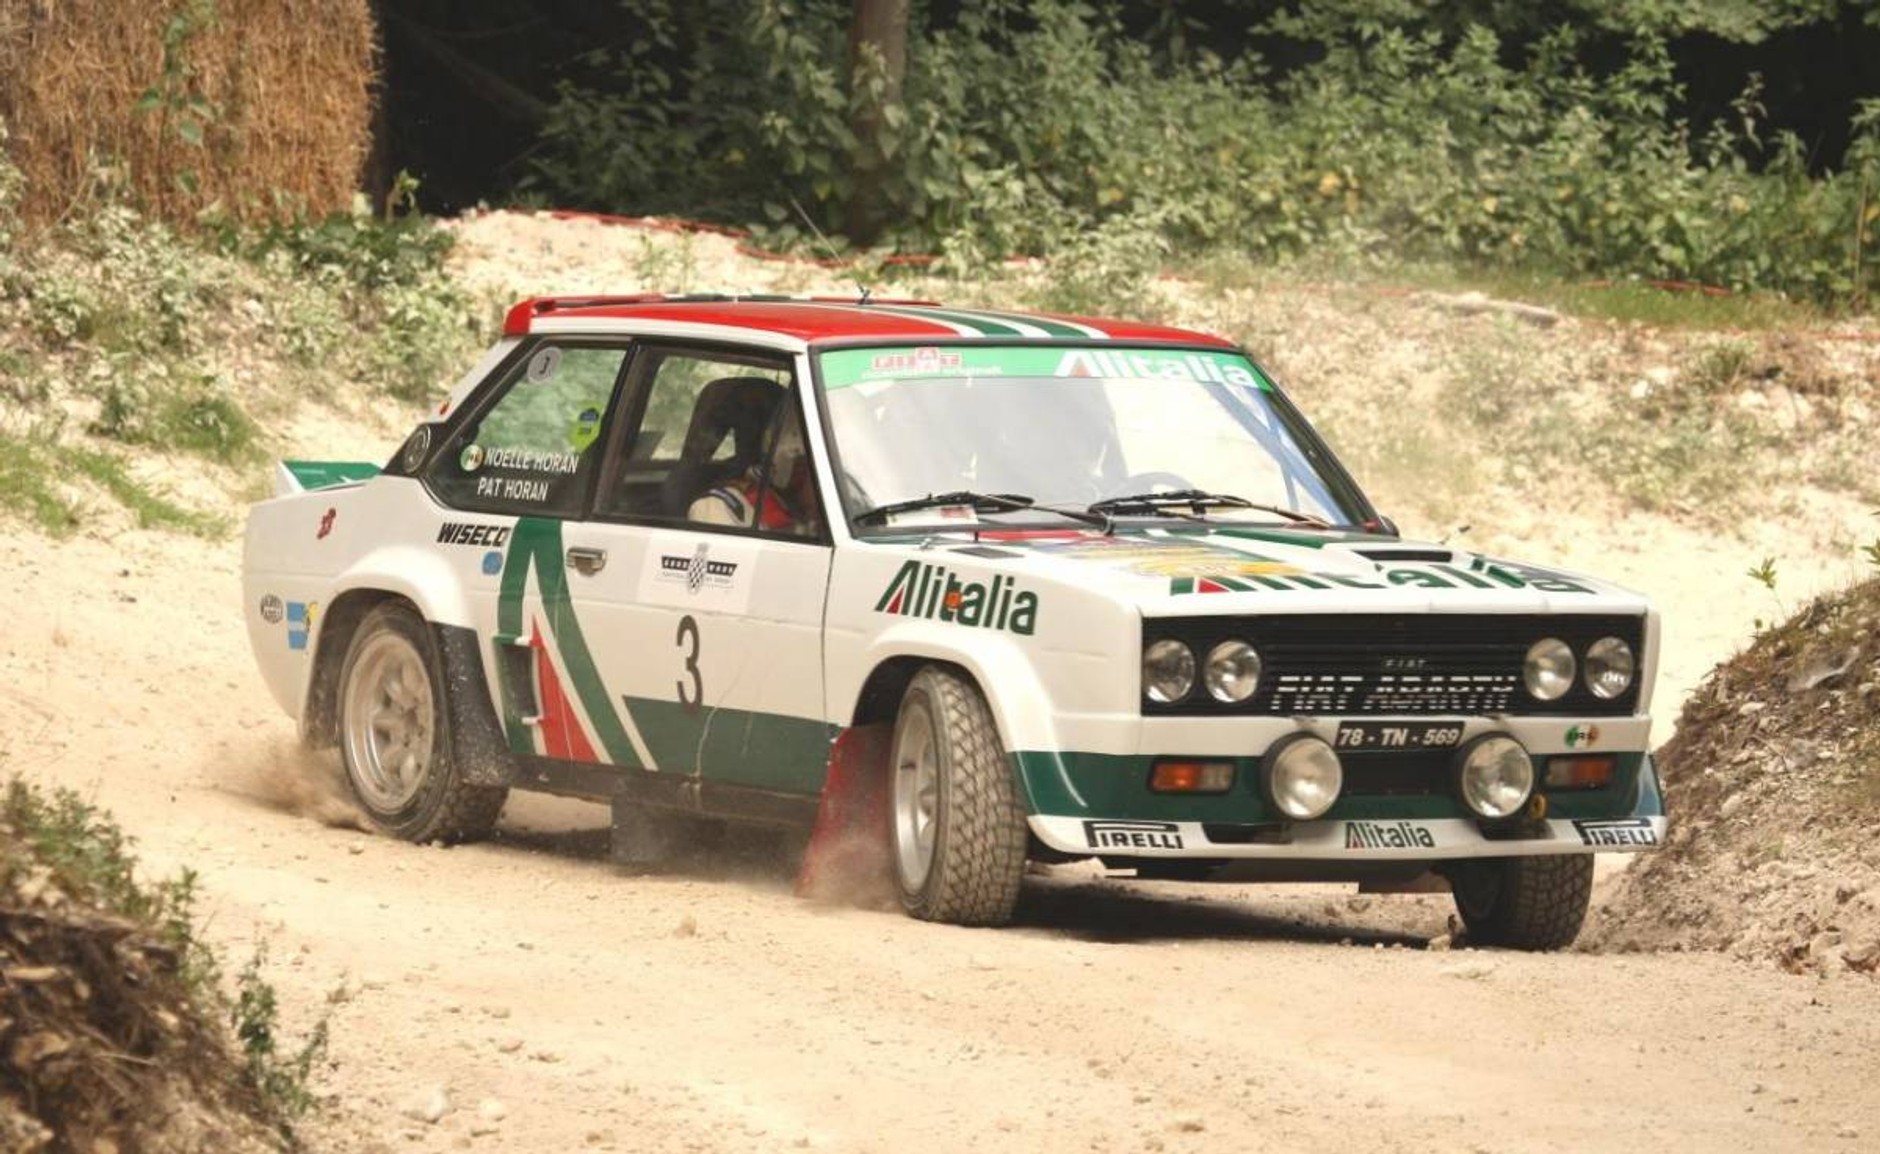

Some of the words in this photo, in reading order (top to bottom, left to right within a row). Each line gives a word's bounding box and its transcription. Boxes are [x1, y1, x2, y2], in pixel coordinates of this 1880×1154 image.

[1054, 350, 1259, 388] Alitalia
[484, 447, 532, 470] NOELLE
[533, 452, 581, 475] HORAN
[477, 476, 502, 497] PAT
[504, 479, 549, 502] HORAN
[437, 521, 511, 547] WISECO
[874, 559, 1039, 636] Alitalia
[676, 614, 703, 717] 3
[1338, 727, 1365, 747] 78
[1380, 727, 1409, 747] TN
[1421, 727, 1460, 747] 569
[1082, 820, 1184, 849] PIRELLI
[1344, 821, 1436, 850] Alitalia
[1571, 817, 1658, 846] PIRELLI
